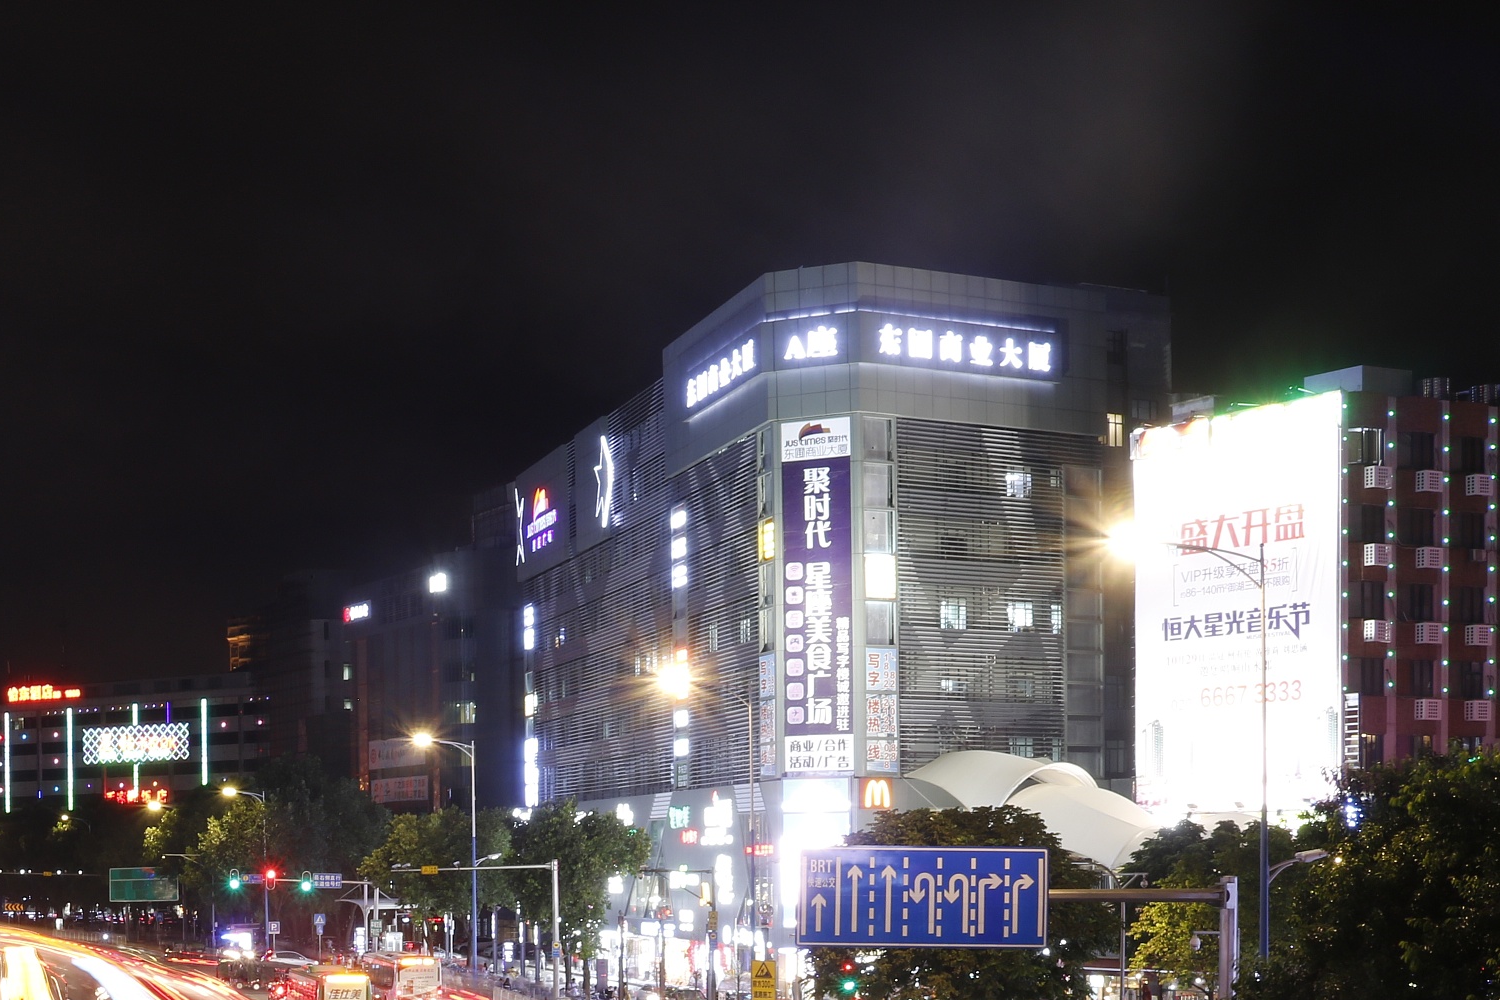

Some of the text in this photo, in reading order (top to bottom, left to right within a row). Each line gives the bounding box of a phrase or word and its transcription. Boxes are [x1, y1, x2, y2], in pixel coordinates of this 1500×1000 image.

[784, 325, 838, 360] A座
[878, 323, 1051, 372] 东圃商业大厦
[784, 444, 848, 460] 东圃商业大厦
[803, 467, 831, 549] 聚时代
[1180, 503, 1305, 556] 盛大开盘
[1162, 601, 1311, 642] 恒大星光音乐节
[805, 562, 832, 725] 星座美食广场
[867, 654, 881, 760] 写字楼热线
[1200, 685, 1247, 707] 6667
[1254, 679, 1301, 704] 3333
[790, 738, 849, 752] 商业/合作
[789, 755, 850, 769] 活动/广告
[810, 859, 833, 873] BRT
[807, 876, 836, 888] 快速公交
[271, 923, 278, 931] P
[329, 988, 362, 1000] 佳仕美
